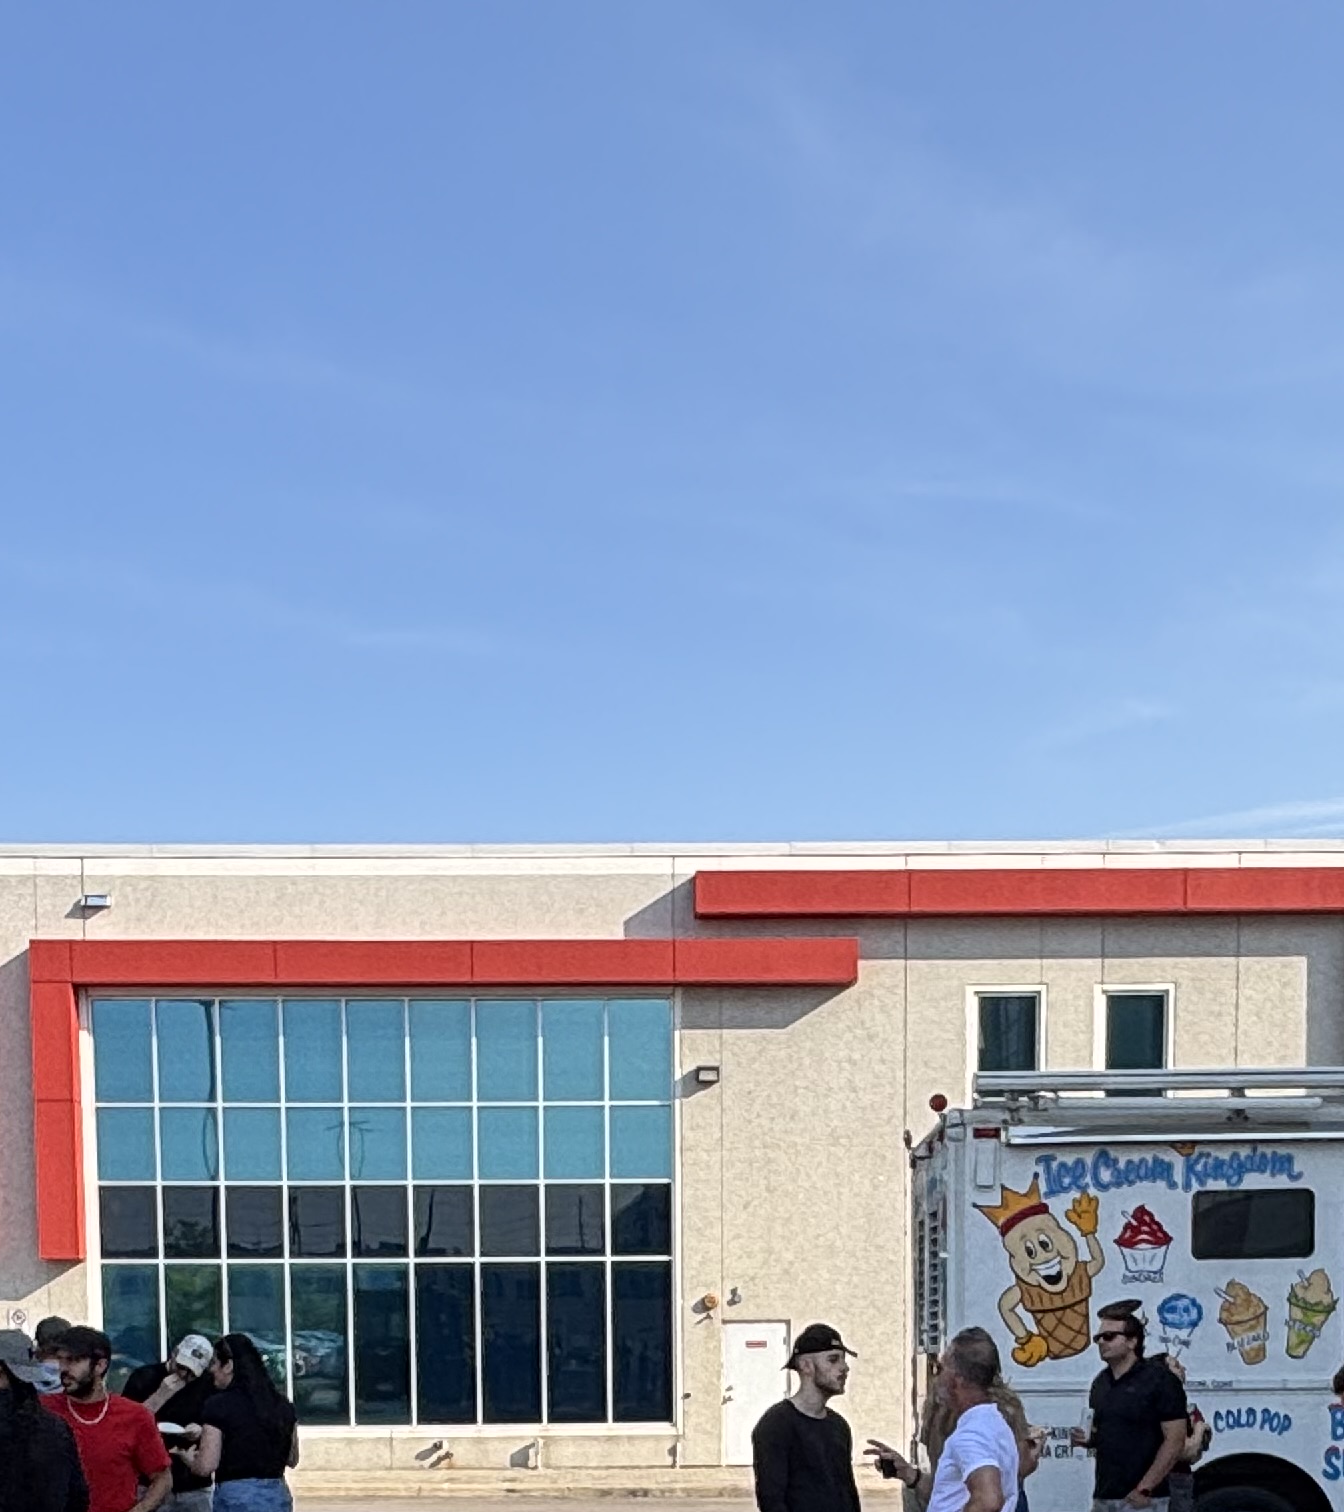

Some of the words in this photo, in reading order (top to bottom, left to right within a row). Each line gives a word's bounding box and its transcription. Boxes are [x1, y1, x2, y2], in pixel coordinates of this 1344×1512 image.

[1035, 1154, 1089, 1198] Ice
[1090, 1149, 1179, 1192] Cream
[1182, 1145, 1304, 1192] Kingdom
[1213, 1406, 1257, 1433] COLD
[1259, 1406, 1292, 1436] POP
